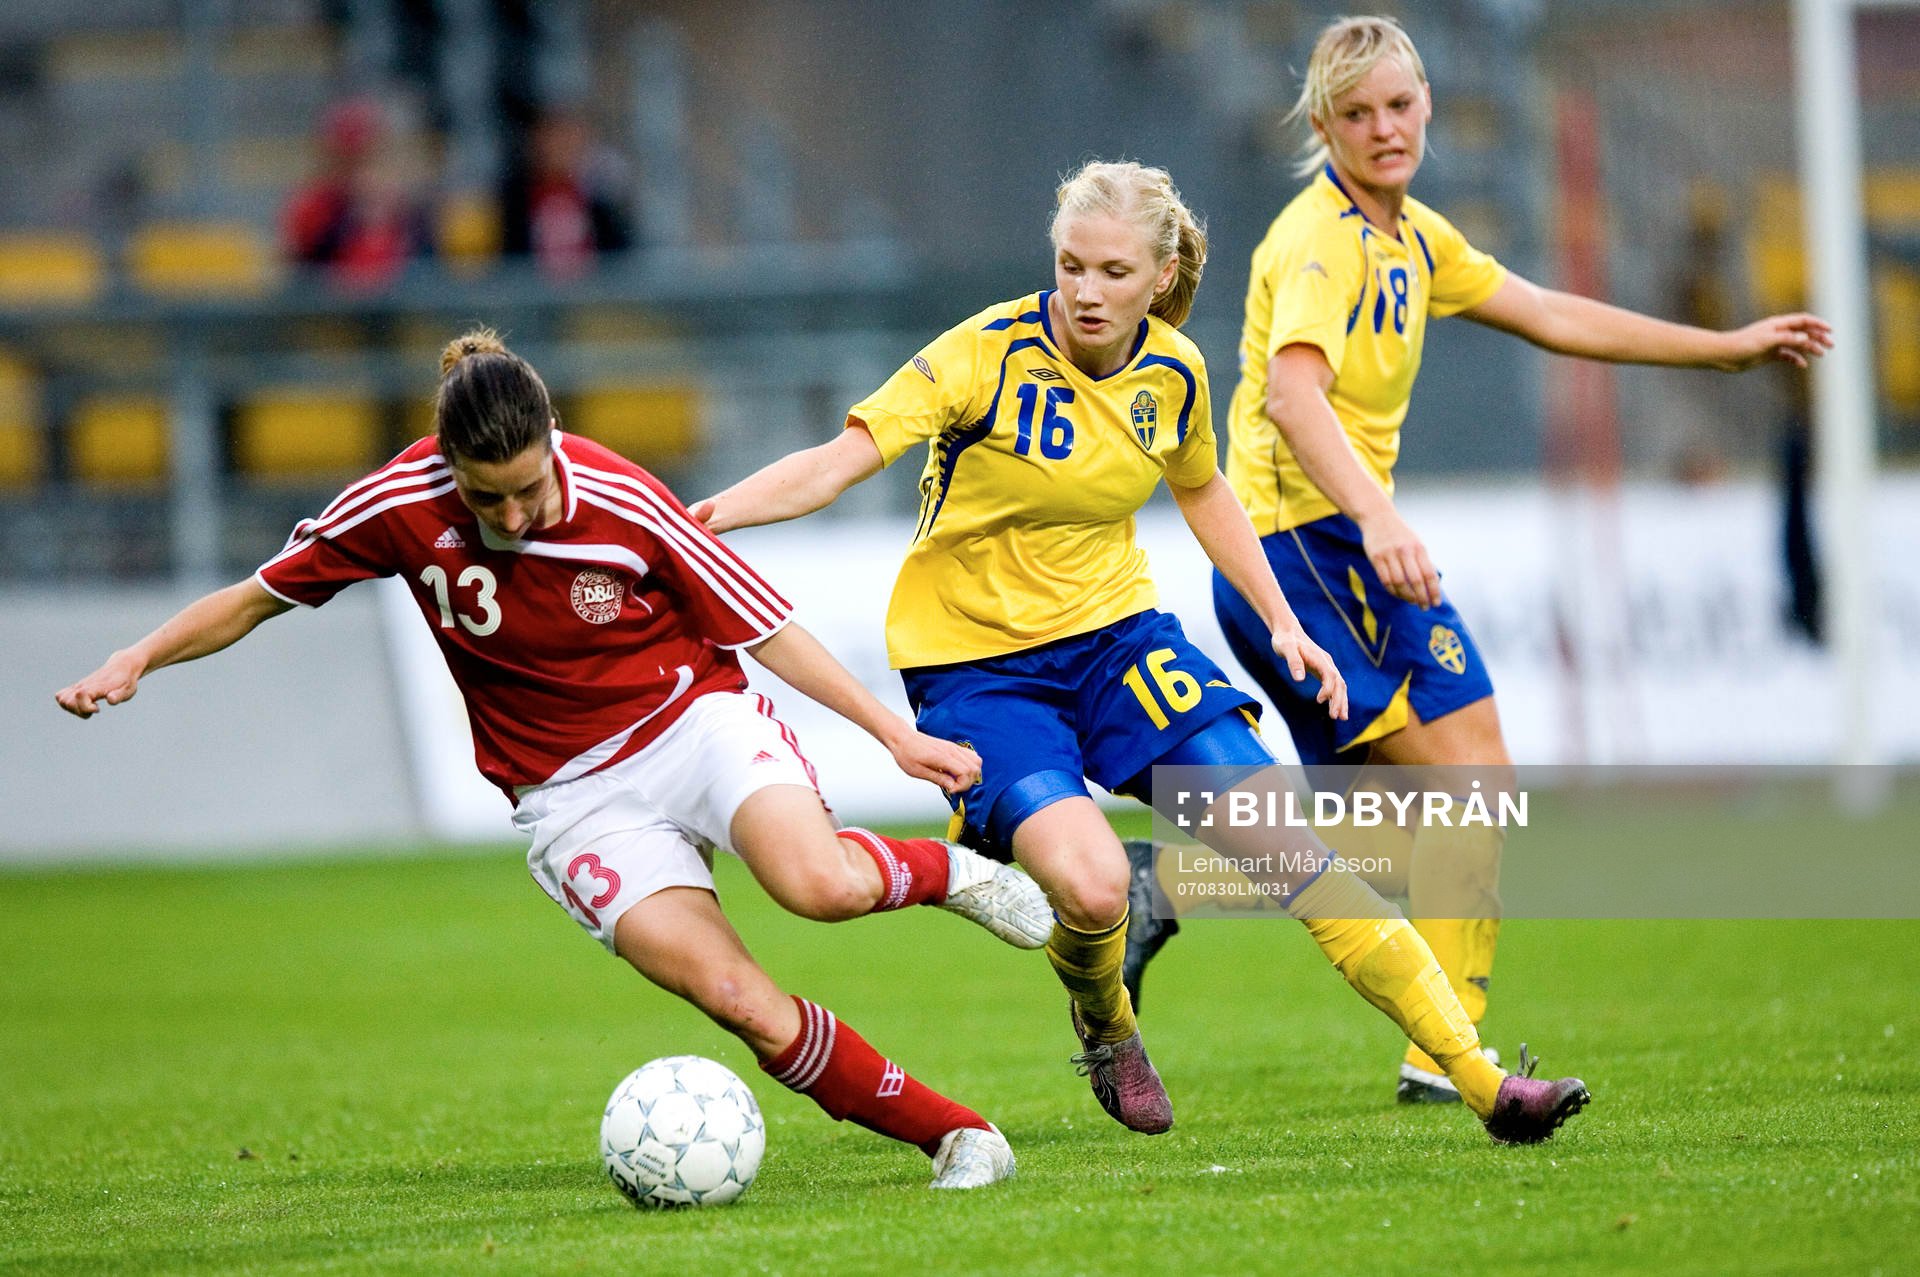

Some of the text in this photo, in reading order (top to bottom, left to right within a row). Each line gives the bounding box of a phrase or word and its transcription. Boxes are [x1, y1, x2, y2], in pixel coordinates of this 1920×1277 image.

[1373, 266, 1408, 335] 18
[1013, 382, 1076, 461] 16
[434, 539, 466, 548] adidas
[419, 564, 502, 637] 13
[582, 583, 616, 604] DBU
[1122, 647, 1202, 731] 16
[562, 853, 621, 930] 13
